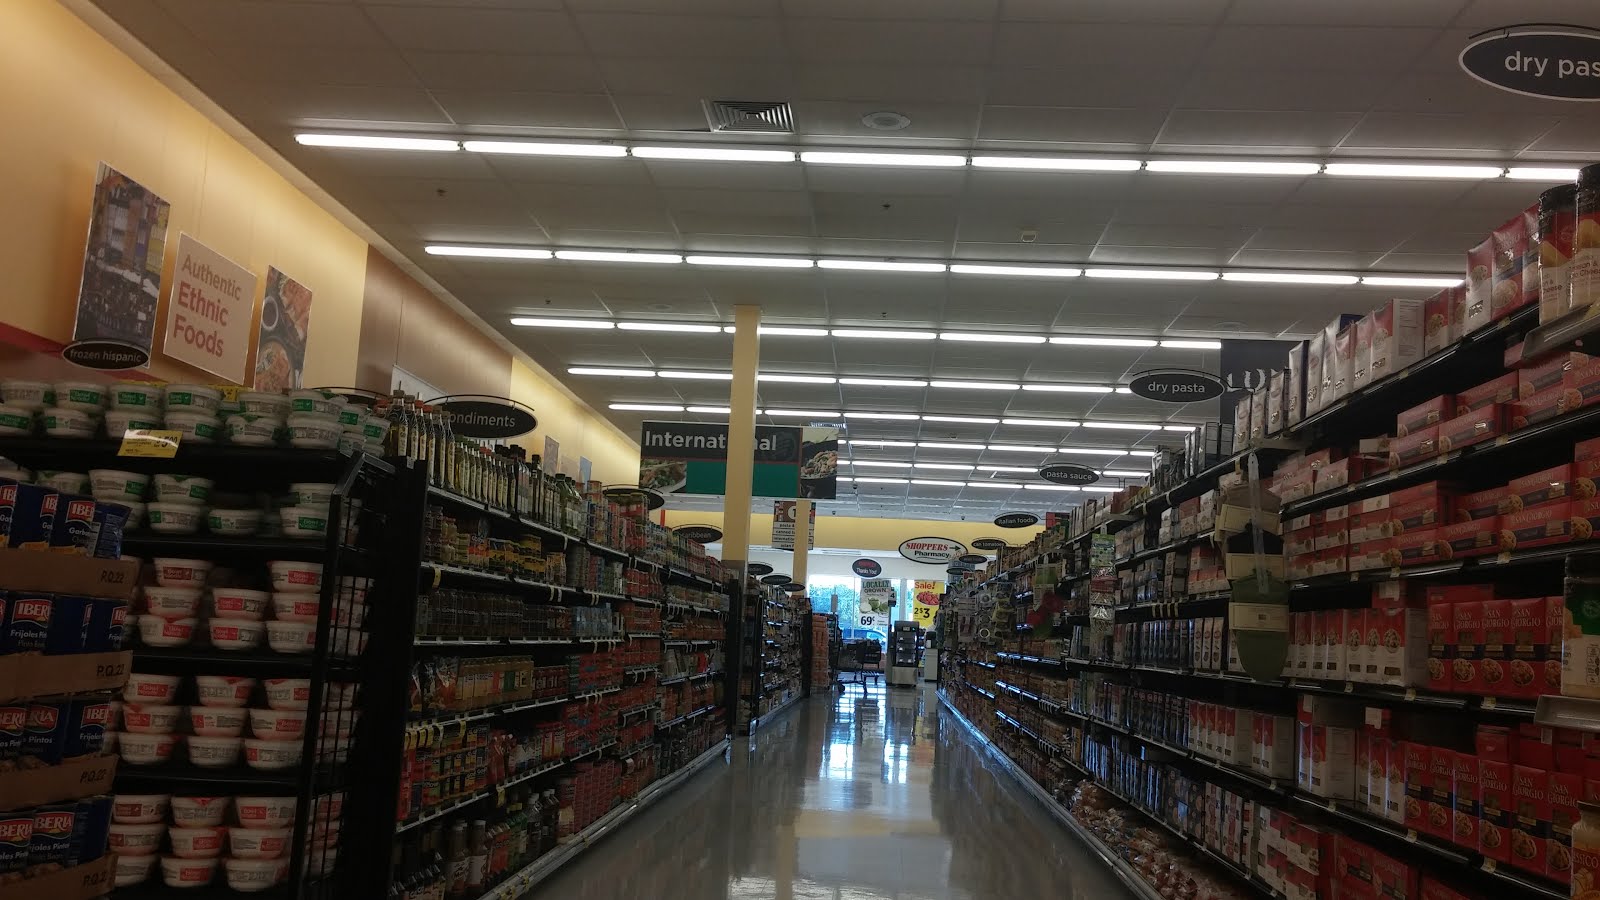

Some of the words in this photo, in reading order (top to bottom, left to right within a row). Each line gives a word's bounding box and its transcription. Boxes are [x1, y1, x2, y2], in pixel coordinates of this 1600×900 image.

[1504, 50, 1548, 77] dry
[181, 254, 242, 301] Authentic
[177, 281, 229, 326] Ethnic
[173, 314, 224, 357] Foods
[70, 348, 100, 360] frozen
[102, 351, 142, 363] hispanic
[1148, 380, 1169, 395] dry
[1172, 383, 1206, 395] pasta
[449, 411, 516, 428] ondiments
[644, 430, 777, 452] Internatal
[1069, 473, 1093, 481] sauce
[905, 542, 948, 551] SHOPPERS
[914, 550, 950, 558] Pharmacy
[862, 580, 889, 588] LOCALLY
[914, 581, 935, 589] Sale!
[17, 602, 49, 618] IBER
[28, 735, 53, 744] Pintos
[1512, 783, 1544, 801] GIORGIO
[36, 816, 72, 832] BERIA
[1573, 853, 1599, 869] SSICO
